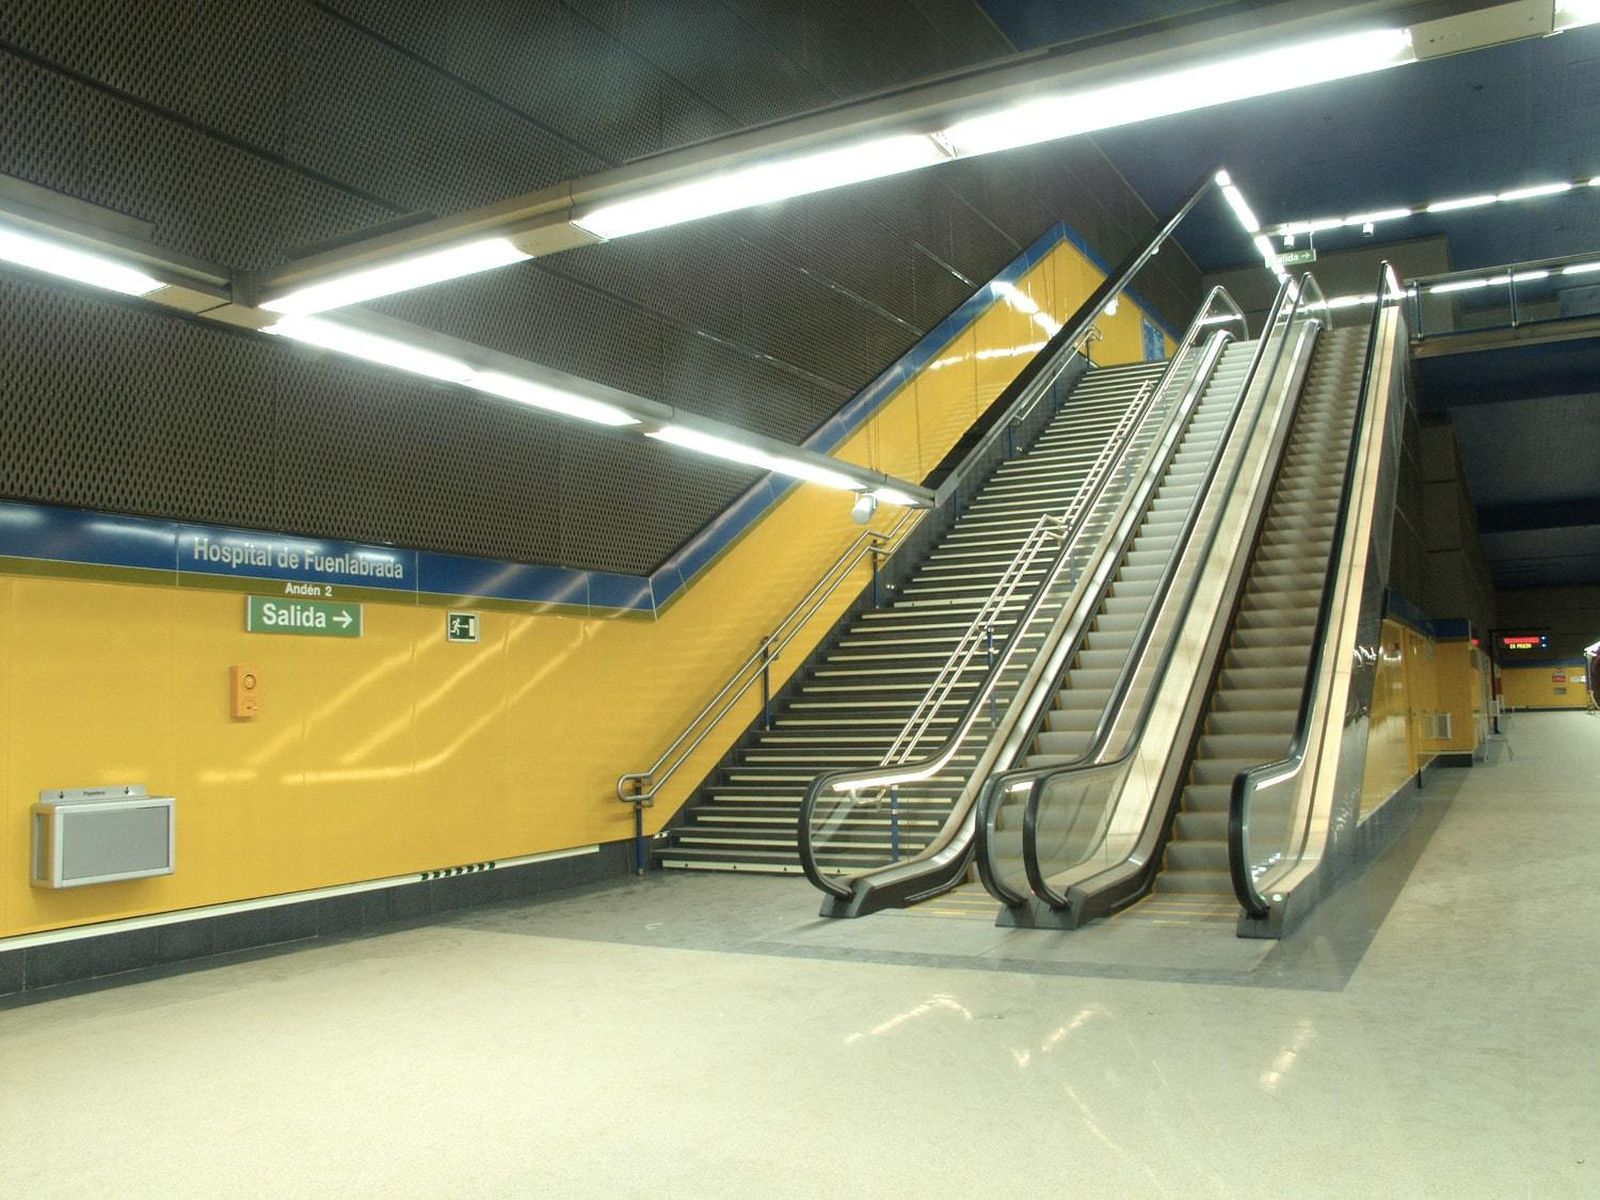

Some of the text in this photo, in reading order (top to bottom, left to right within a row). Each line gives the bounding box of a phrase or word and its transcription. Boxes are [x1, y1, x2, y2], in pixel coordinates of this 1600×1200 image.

[193, 535, 404, 579] Hospital de Fuenlabrada
[324, 585, 333, 597] 2
[262, 603, 327, 628] Salida
